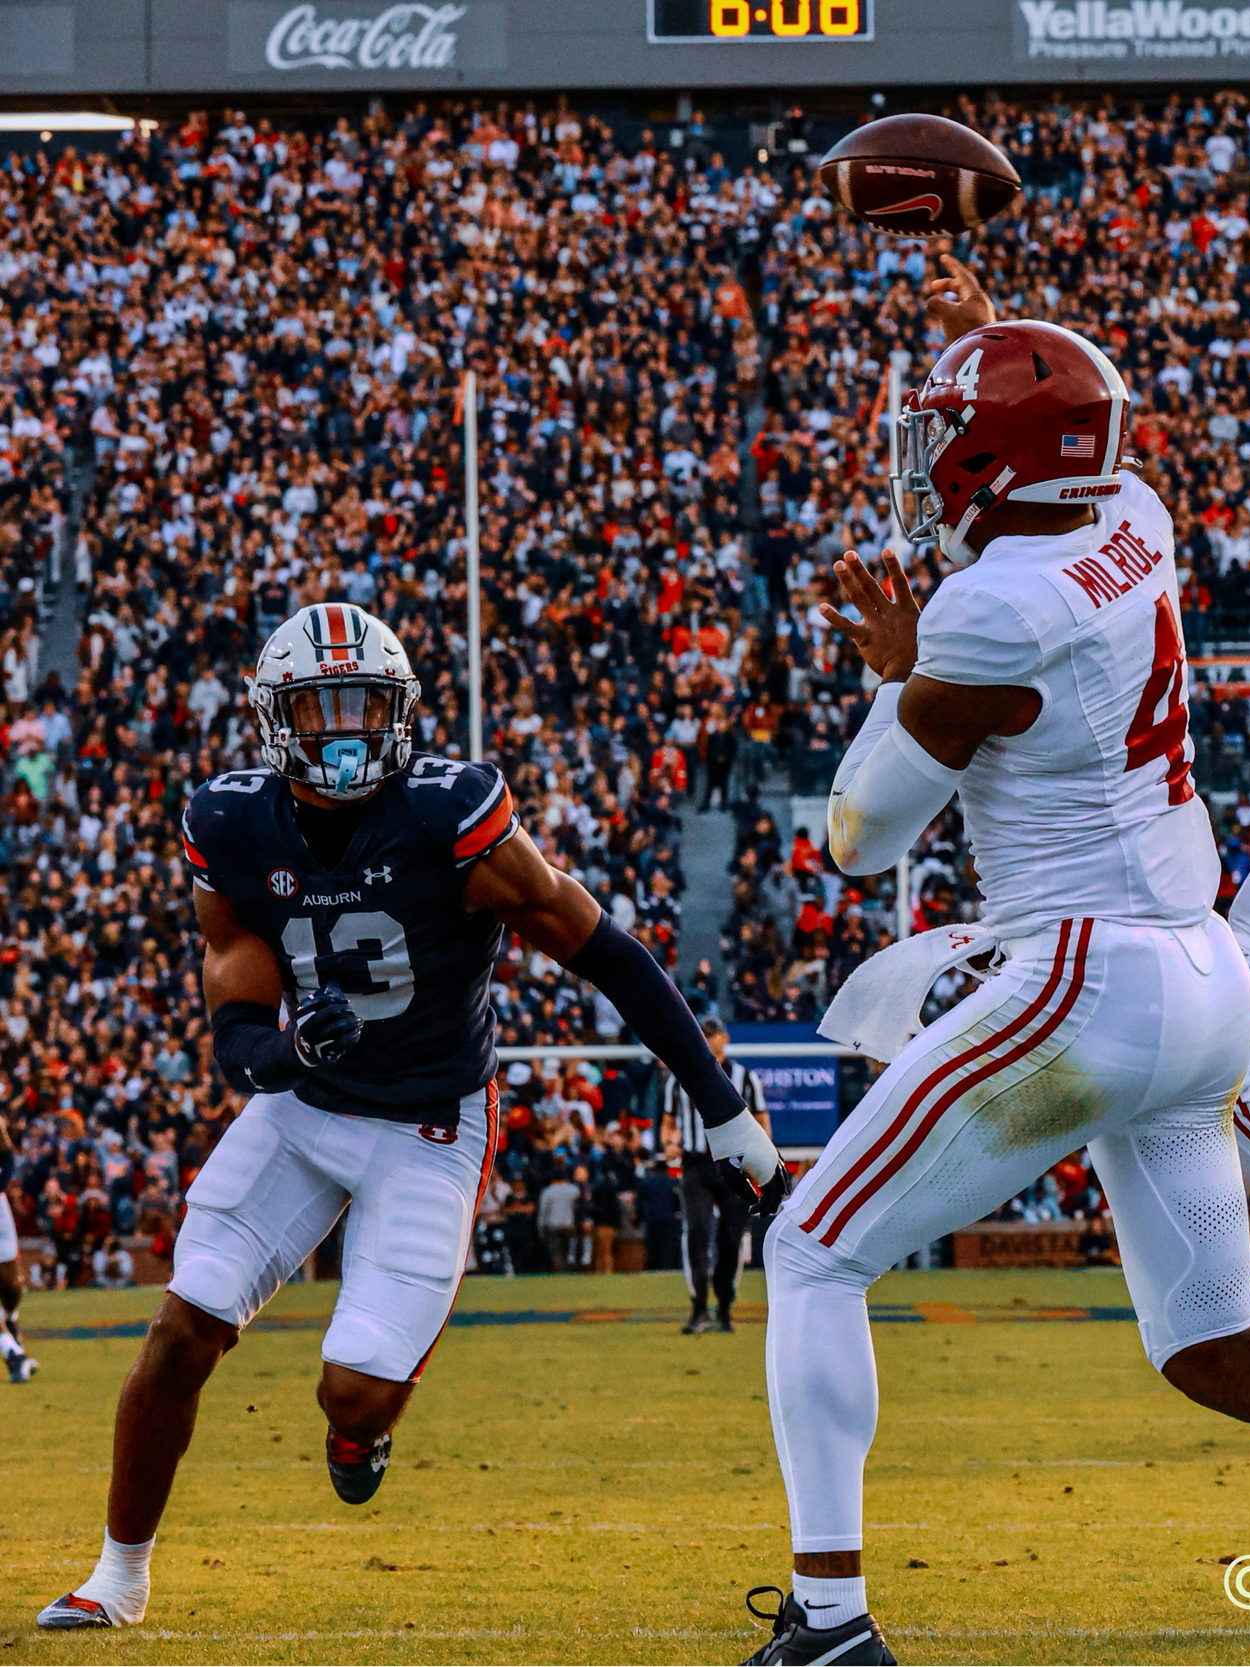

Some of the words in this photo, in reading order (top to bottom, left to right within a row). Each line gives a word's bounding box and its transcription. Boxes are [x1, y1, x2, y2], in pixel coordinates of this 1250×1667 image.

[265, 3, 467, 70] Coca-Cola
[1029, 38, 1128, 58] Pressure
[1134, 38, 1217, 58] Treated
[955, 348, 984, 401] 4
[1062, 519, 1163, 609] MILROE
[1125, 591, 1194, 806] 4
[270, 870, 296, 897] SEC
[302, 891, 362, 907] AUBURN
[281, 911, 416, 1022] 13
